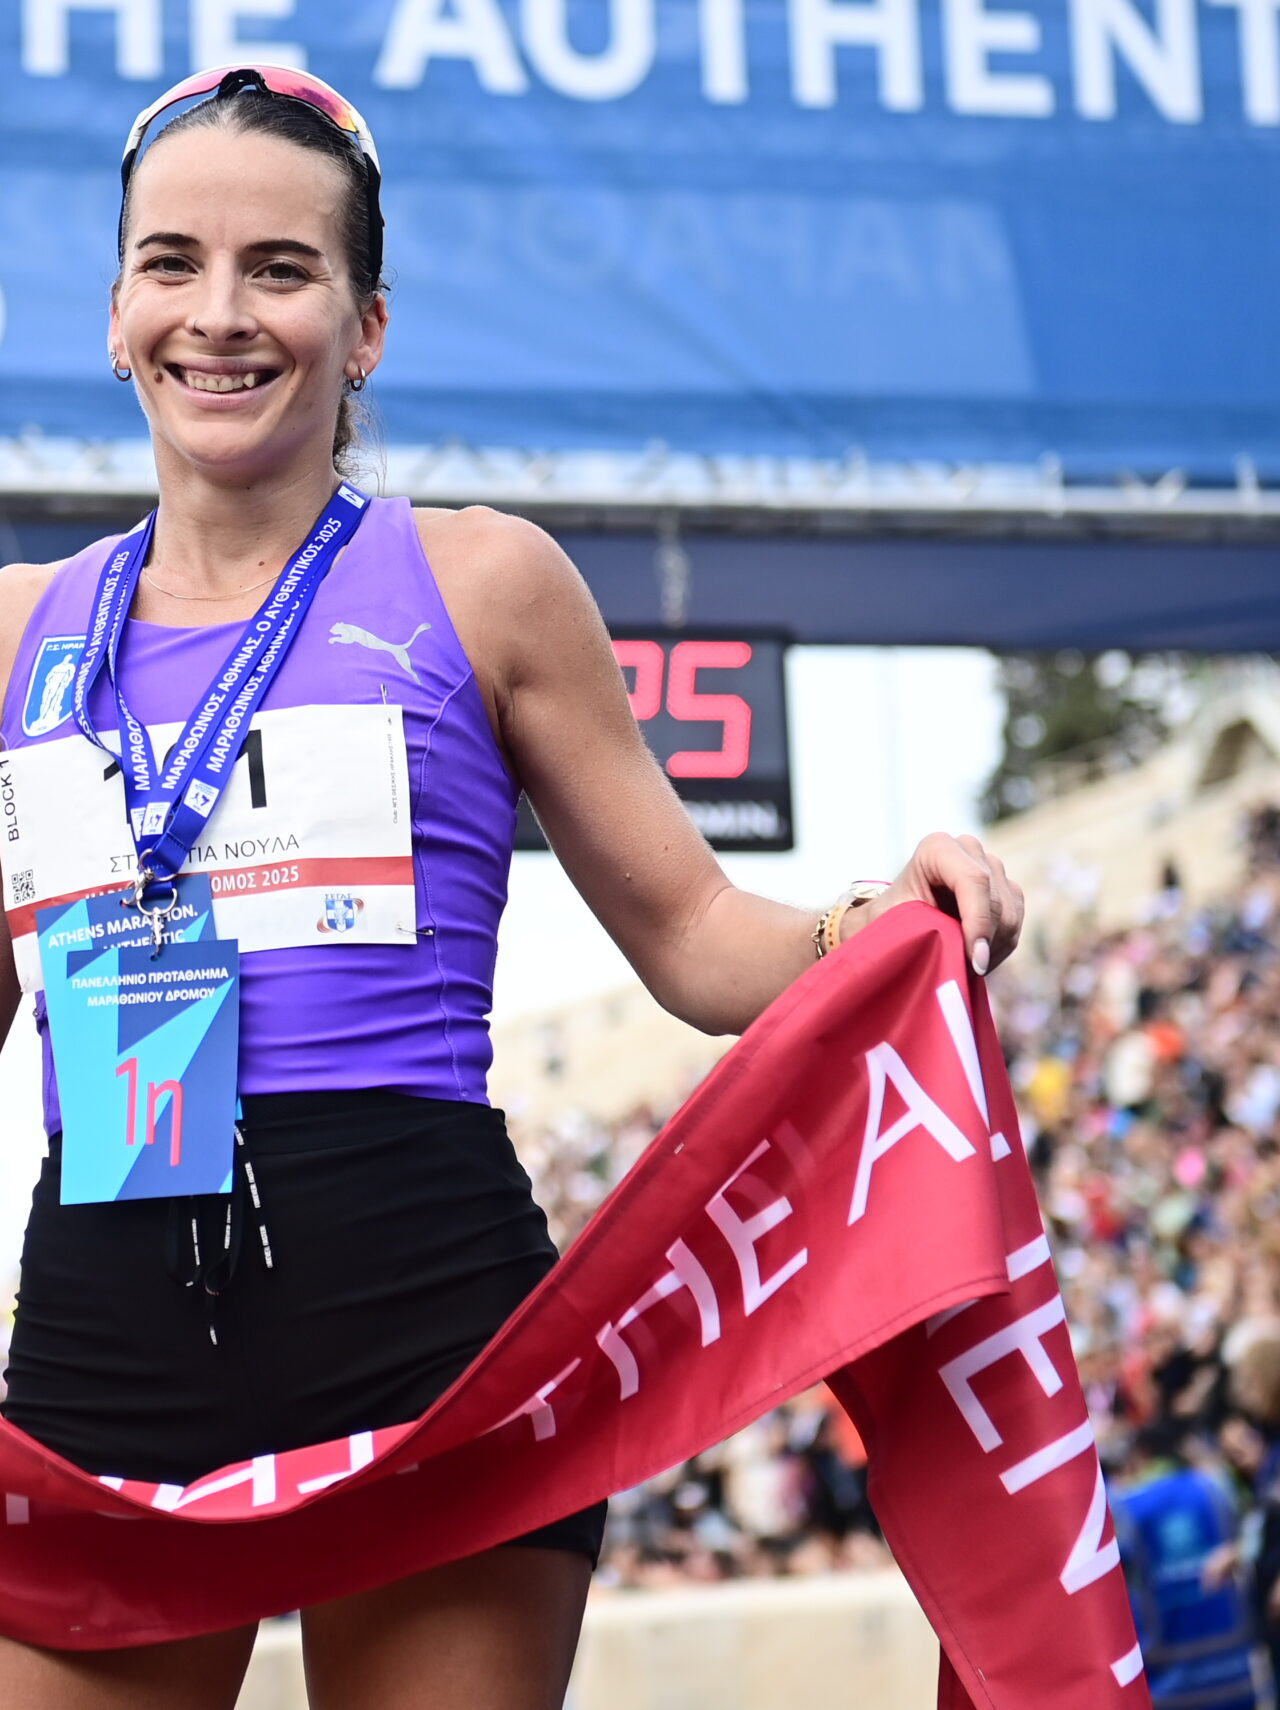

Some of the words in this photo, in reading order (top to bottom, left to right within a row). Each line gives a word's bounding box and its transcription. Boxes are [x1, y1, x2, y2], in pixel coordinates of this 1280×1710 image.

[109, 551, 130, 575] 2025
[162, 693, 226, 790] ΜΑΡΑΘΩΝΙΟΣ
[217, 634, 265, 692] ΑΘΗΝΑΣ.
[264, 543, 324, 620] ΑΥΘΕΝΤΙΚΟΣ
[315, 517, 342, 543] 2025
[206, 675, 265, 774] ΜΑΡΑΘΩΝΙΟΣ
[0, 773, 20, 842] BLOCK
[110, 845, 218, 873] ΣΤΤΙΑ
[224, 833, 300, 860] ΝΟΥΛΑ
[211, 872, 257, 892] ΟΜΟΣ
[262, 865, 300, 887] 2025
[48, 923, 105, 949] ATHENS
[107, 904, 199, 936] MARAON.
[72, 973, 147, 989] ΠΑΝΕΛΛΗΝΙΟ
[148, 967, 229, 984] ΠΡΩΤΑΘΛΗΜΑ
[87, 991, 163, 1007] ΜΑΡΑΘΩΝΙΟΥ
[165, 987, 216, 1002] ΔΡΟΜΟΥ
